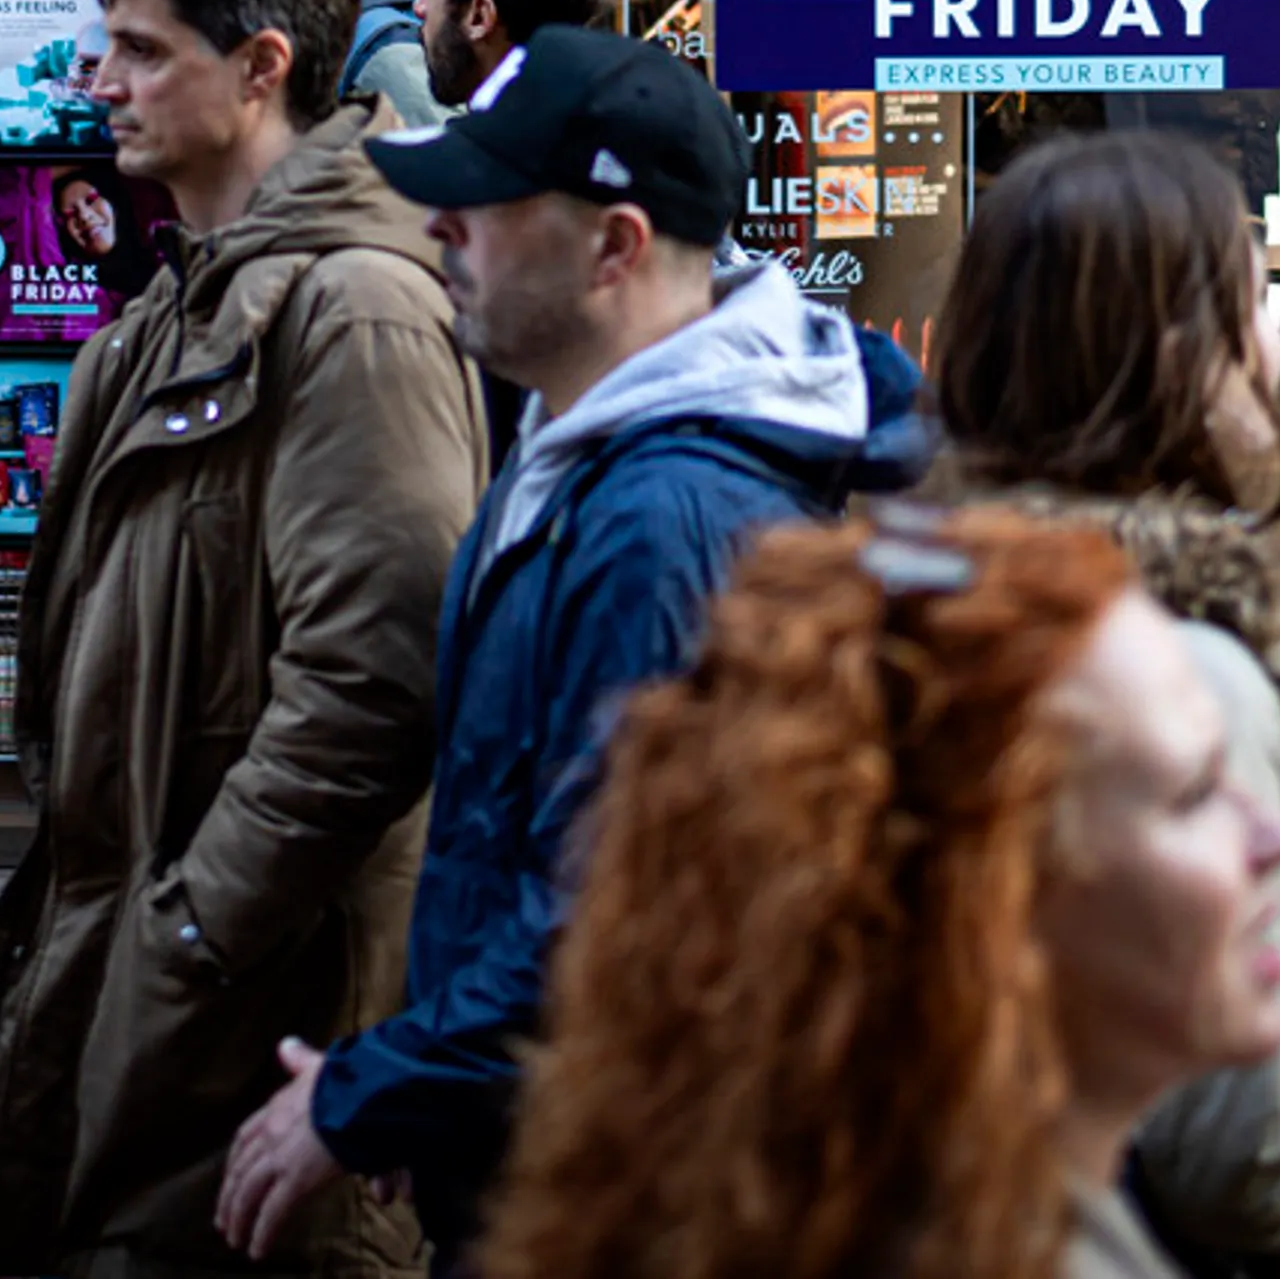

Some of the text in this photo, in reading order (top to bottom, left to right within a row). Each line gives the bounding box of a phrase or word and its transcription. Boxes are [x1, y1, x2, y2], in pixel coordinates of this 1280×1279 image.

[15, 0, 77, 14] FEELING
[887, 62, 1211, 85] EXPRESS YOUR BEAUTY
[736, 112, 869, 143] UALS
[747, 177, 915, 214] LIESKIN
[11, 264, 98, 281] BLACK
[11, 283, 98, 300] FRIDAY
